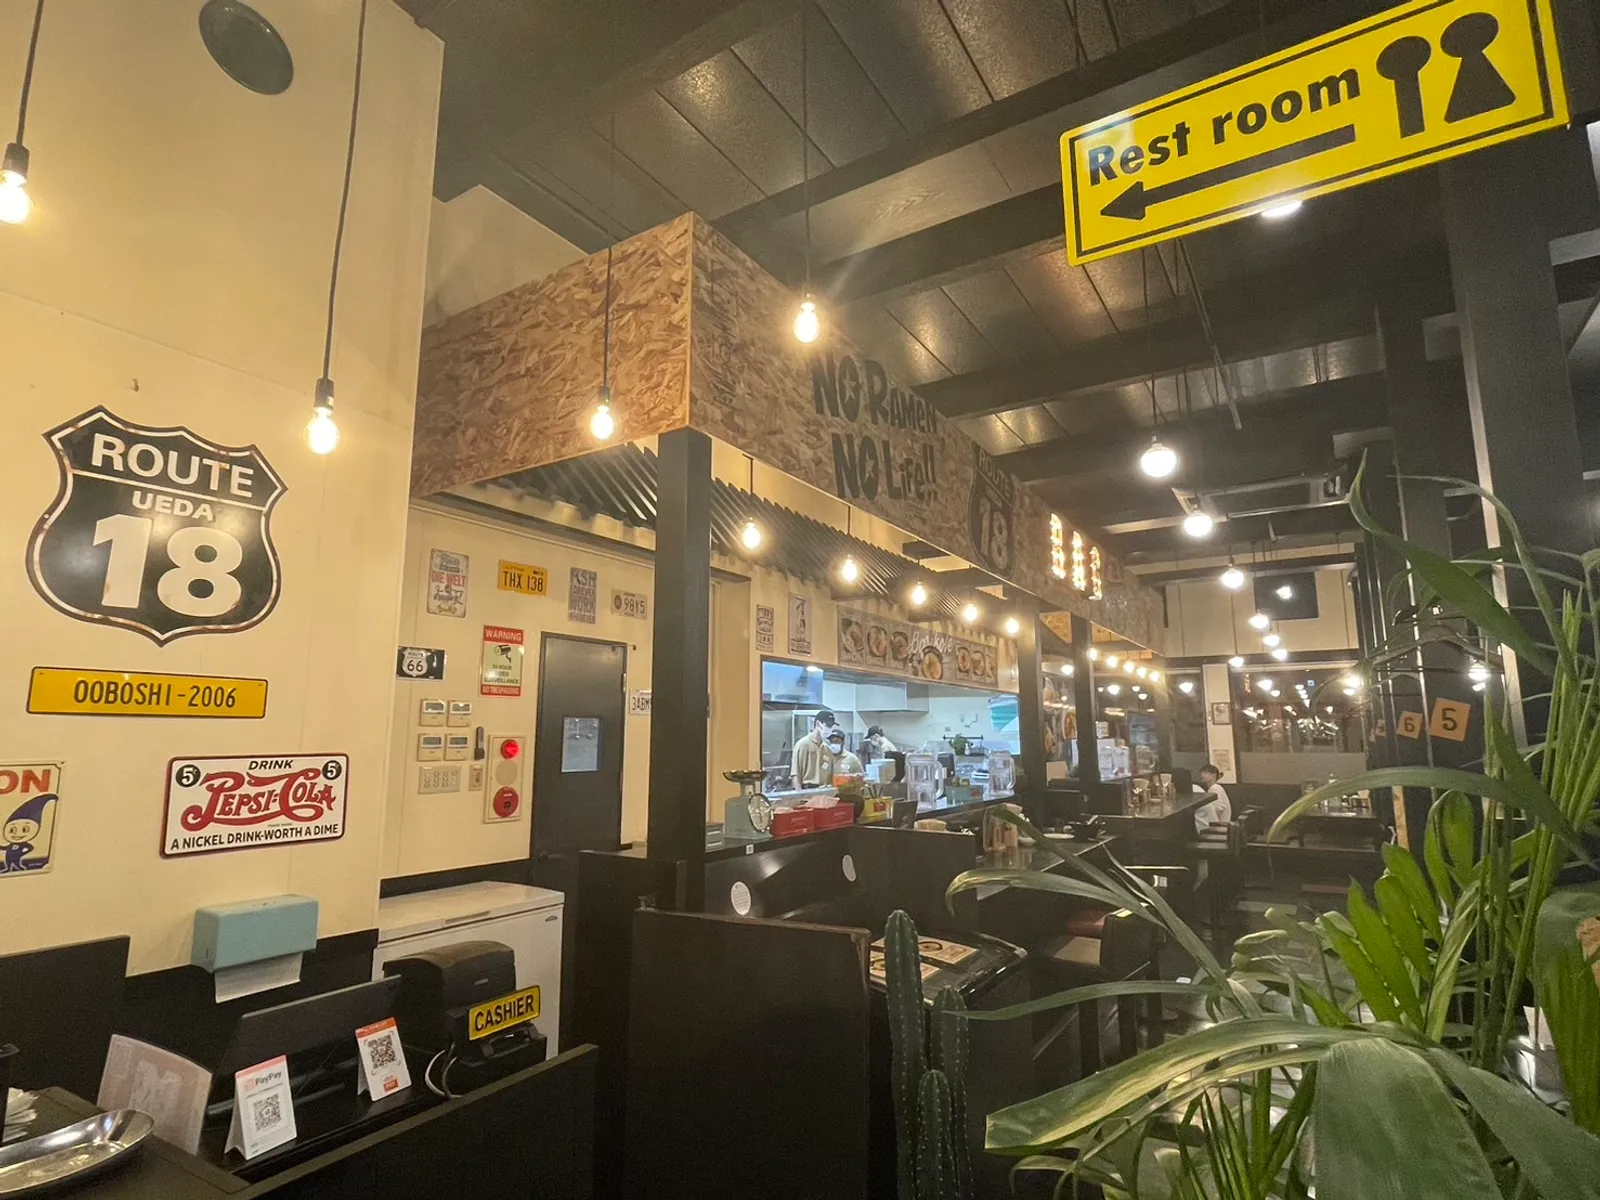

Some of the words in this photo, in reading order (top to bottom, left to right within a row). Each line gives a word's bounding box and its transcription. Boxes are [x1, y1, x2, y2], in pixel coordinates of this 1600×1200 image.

[1088, 120, 1191, 187] Rest
[1212, 67, 1361, 145] room
[811, 350, 861, 423] NO
[91, 432, 255, 498] ROUTE
[830, 432, 880, 501] NO
[132, 490, 215, 522] UEDA
[979, 498, 1009, 571] 18
[92, 513, 243, 618] 18
[502, 570, 523, 590] THX
[527, 575, 545, 593] 138
[485, 629, 522, 642] WARNING
[407, 660, 423, 672] 66
[1404, 717, 1416, 732] 6
[1441, 707, 1458, 731] 5
[248, 759, 294, 771] DRINK
[171, 838, 180, 850] A
[182, 833, 225, 849] NICKEL
[304, 826, 312, 837] A
[313, 823, 339, 836] DIME
[474, 994, 534, 1032] CASHIER
[255, 1070, 283, 1086] PayPay
